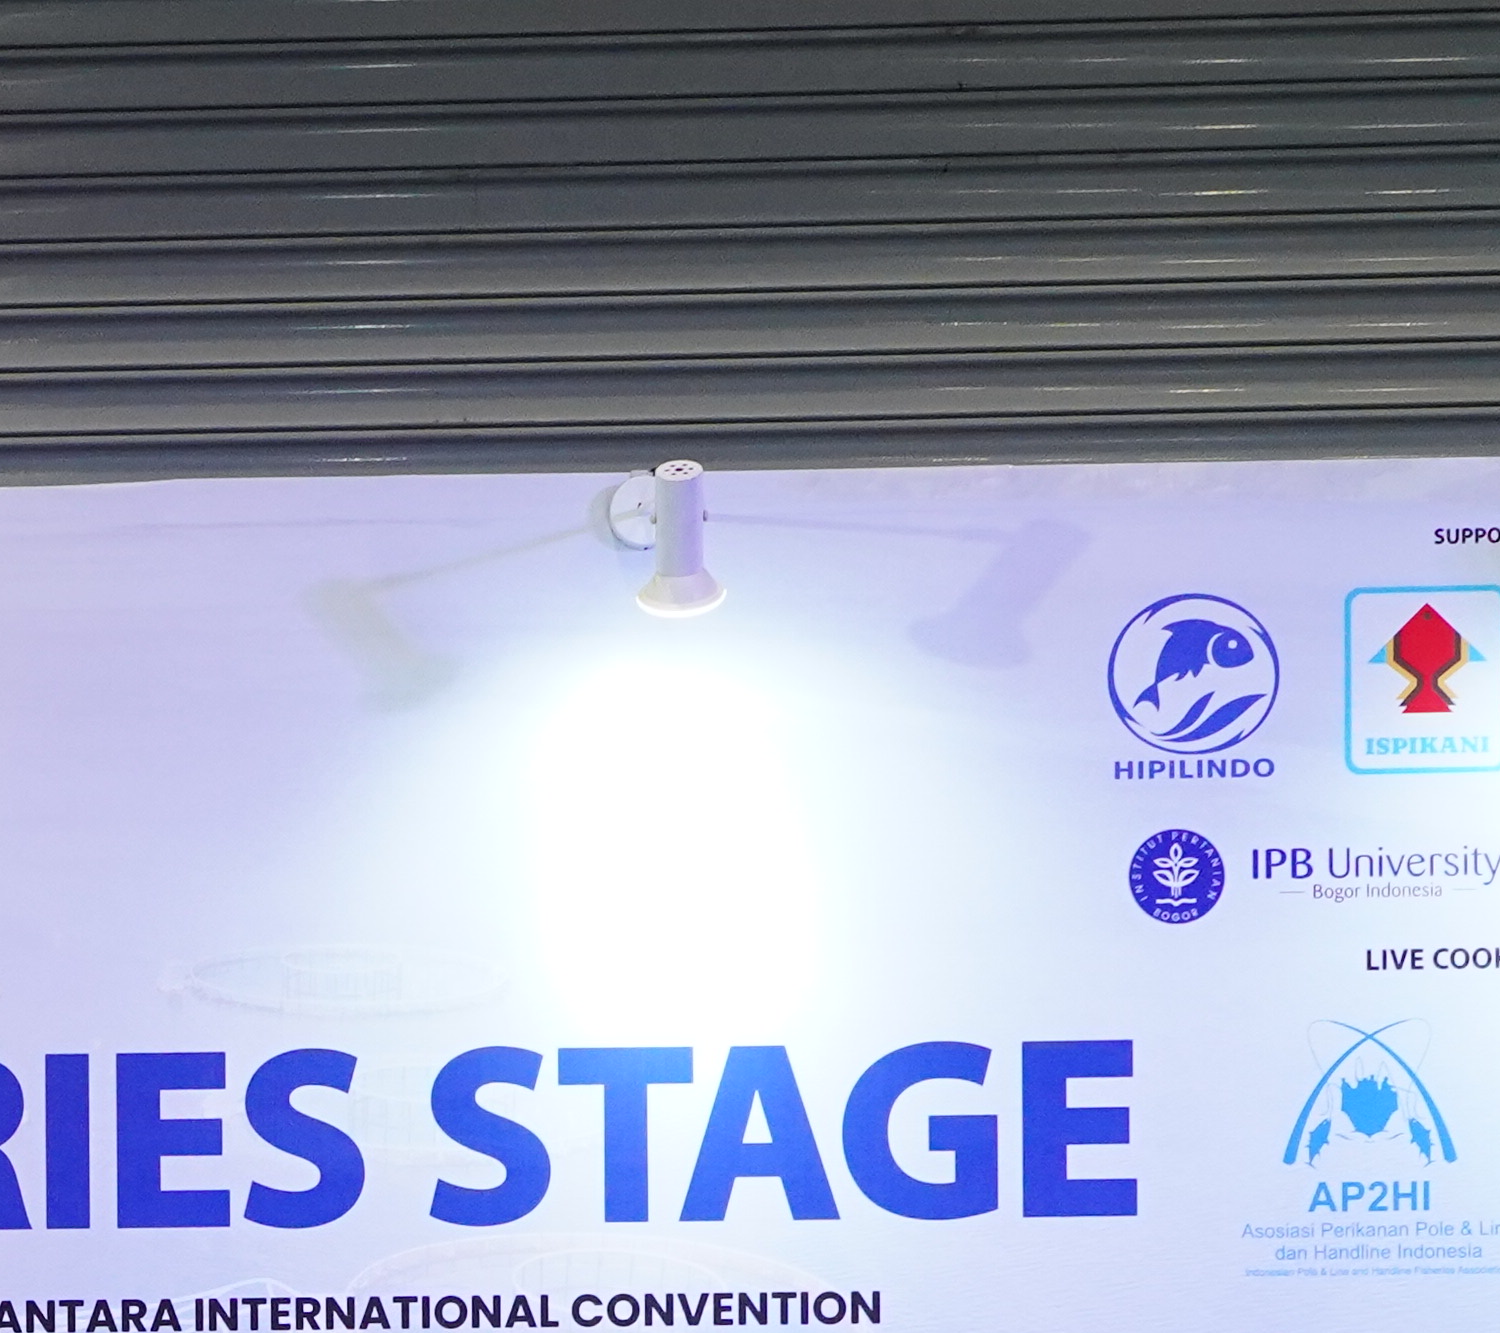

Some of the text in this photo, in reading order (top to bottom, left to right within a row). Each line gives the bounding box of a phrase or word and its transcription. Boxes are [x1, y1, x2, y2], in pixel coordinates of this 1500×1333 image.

[1365, 735, 1491, 756] ISPIKANI
[1114, 758, 1276, 780] HIPILINDO
[1132, 834, 1163, 902] INSTITUT
[1252, 848, 1314, 879] IPB
[1313, 882, 1443, 903] Bogor Indonesia
[1153, 907, 1199, 922] BOGOR
[1366, 948, 1425, 971] LIVE
[429, 1038, 1139, 1228] STAGE
[1308, 1180, 1431, 1213] AP2HI
[1242, 1223, 1315, 1239] Asosiasi
[1321, 1222, 1409, 1238] Perikanan
[1416, 1221, 1455, 1237] Pole
[1460, 1221, 1473, 1237] &
[1275, 1243, 1483, 1261] dan Handline Indonesia
[194, 1294, 559, 1333] INTERNATIONAL
[571, 1290, 881, 1331] CONVENTION
